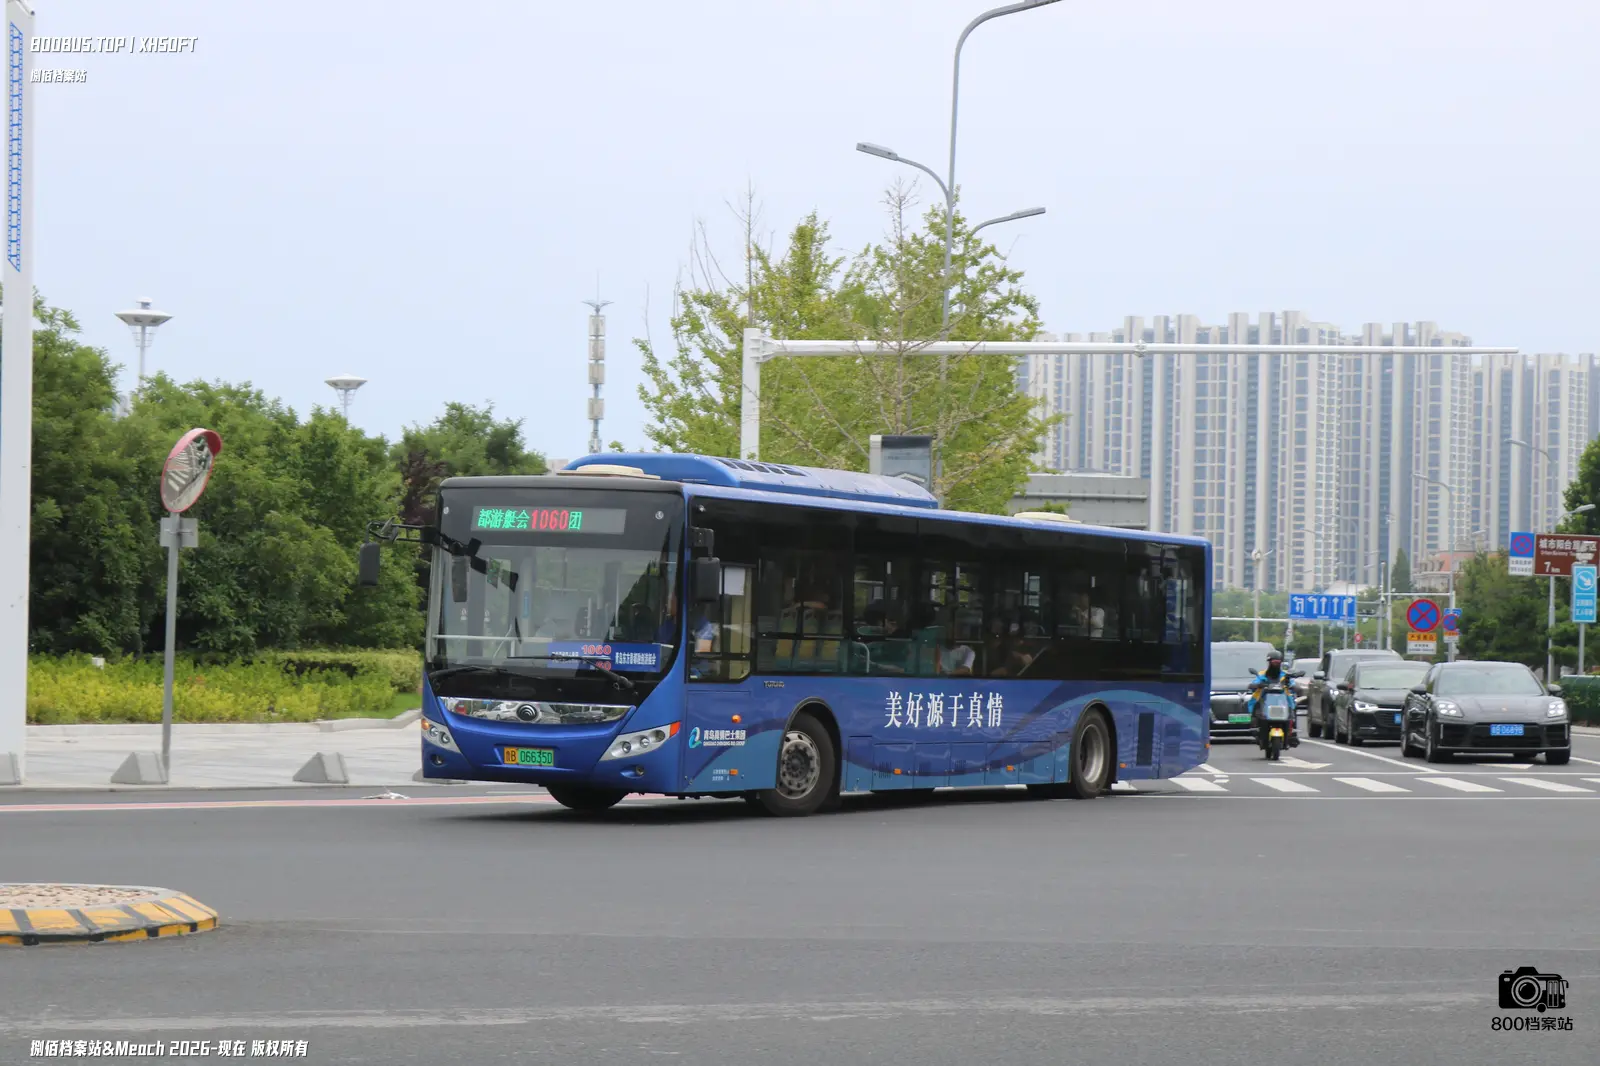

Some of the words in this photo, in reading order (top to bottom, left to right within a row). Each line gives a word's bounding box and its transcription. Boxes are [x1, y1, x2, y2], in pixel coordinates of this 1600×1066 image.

[582, 645, 612, 655] 1060
[884, 690, 1003, 728] 美好源于真情
